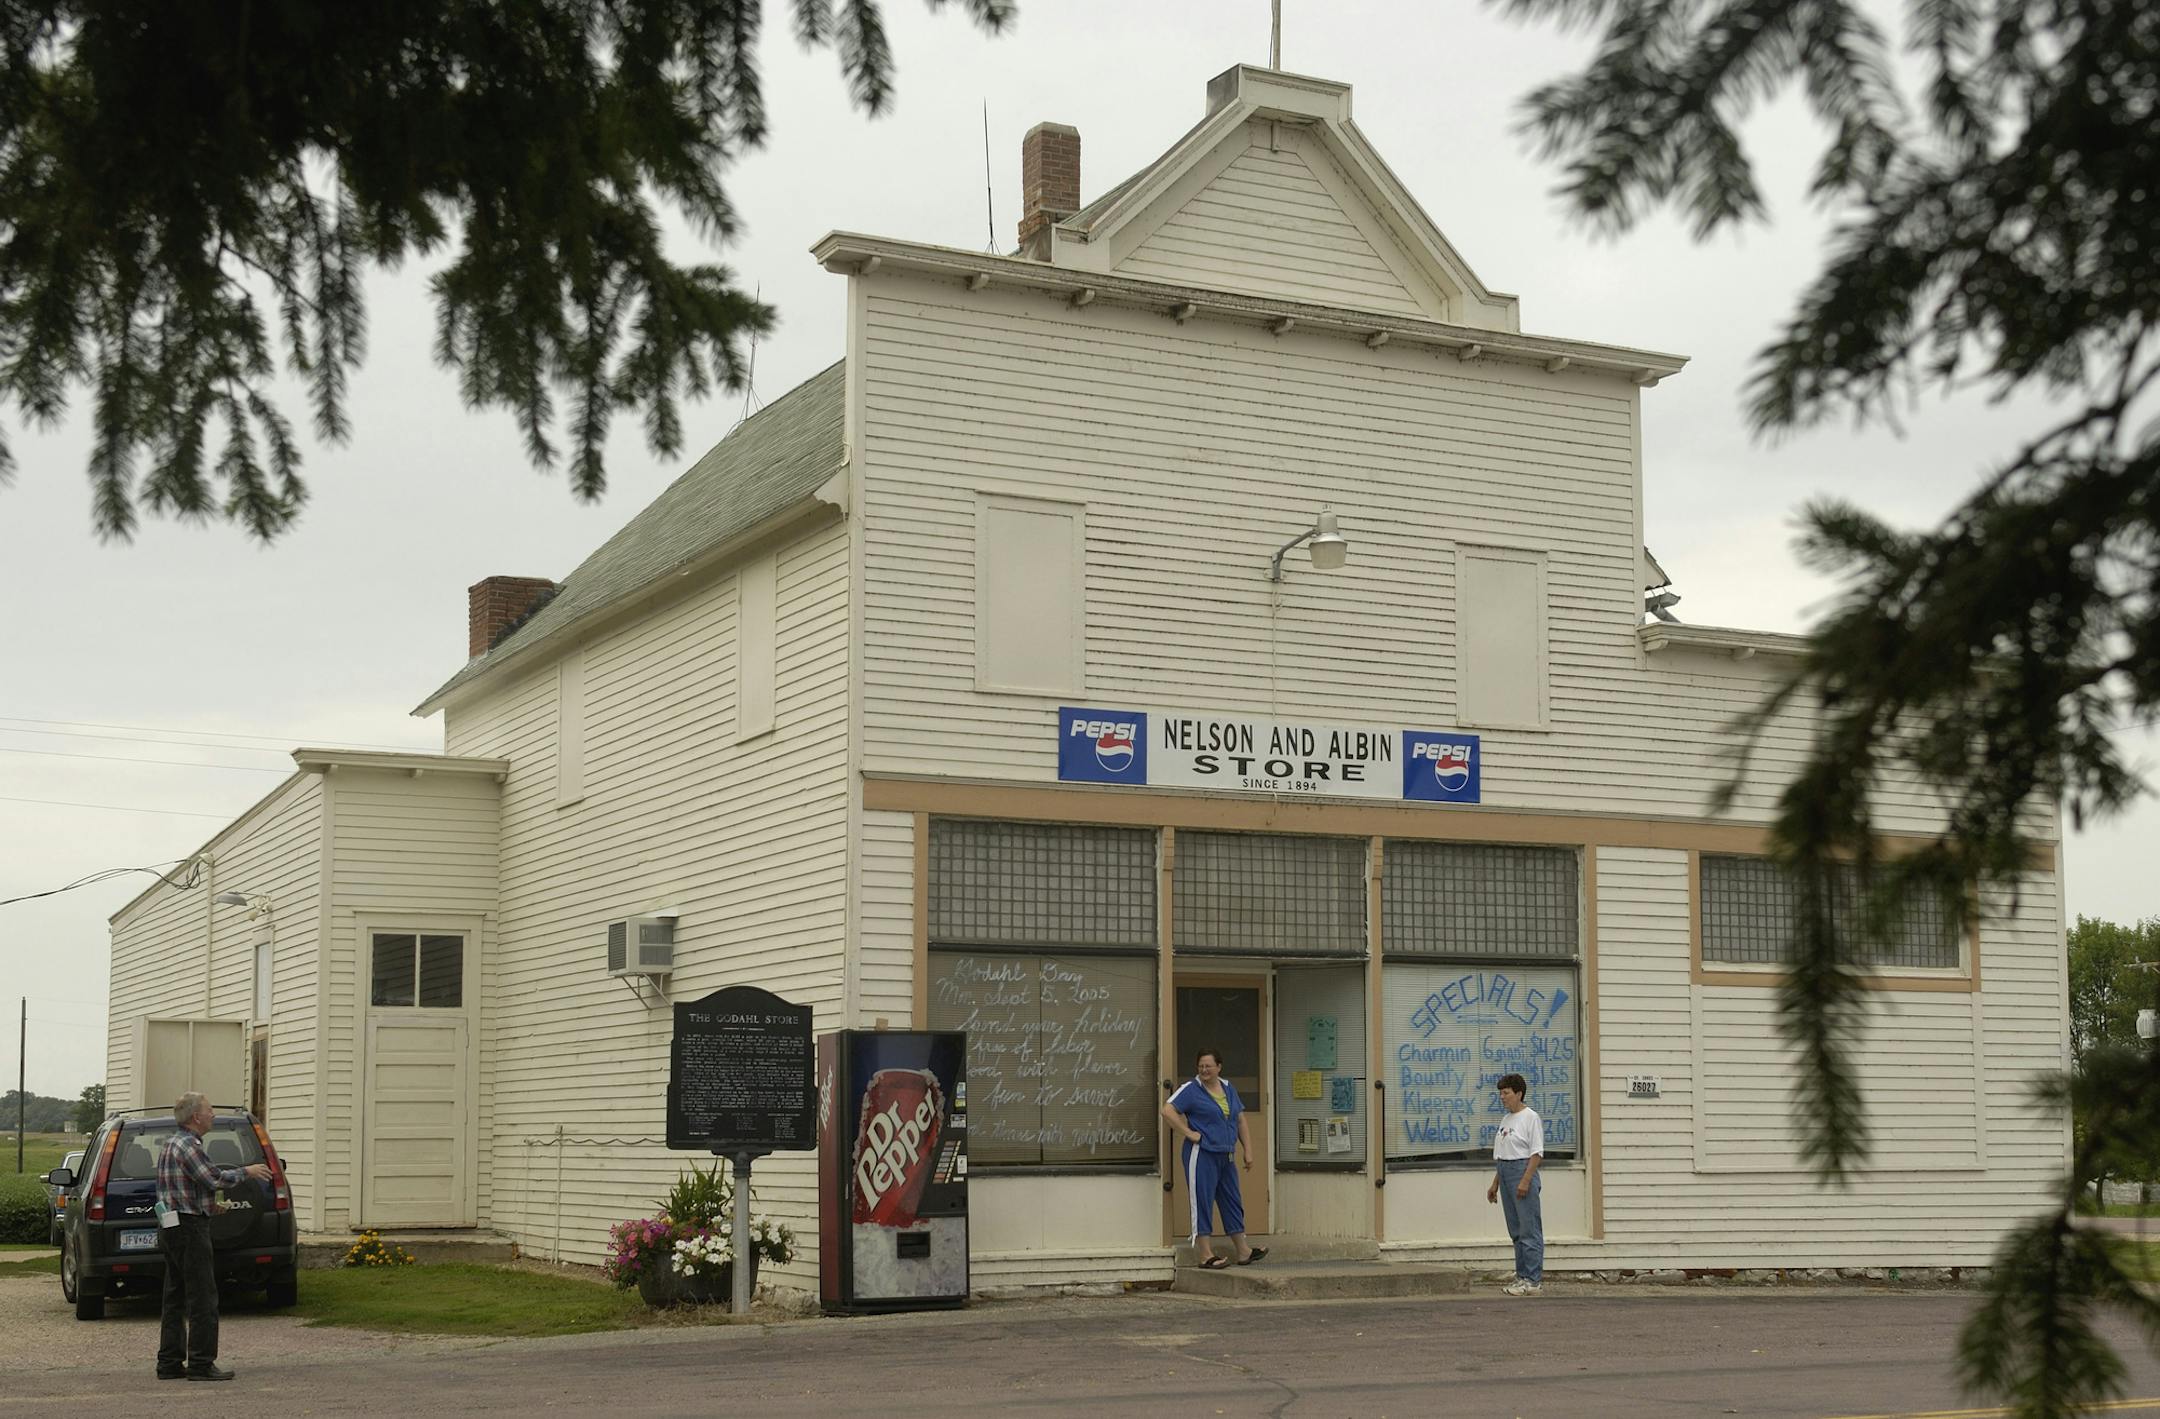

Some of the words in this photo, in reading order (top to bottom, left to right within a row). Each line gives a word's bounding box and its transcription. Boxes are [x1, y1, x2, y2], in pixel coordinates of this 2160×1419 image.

[1070, 719, 1137, 741] PEPSI
[1164, 718, 1254, 754] NELSON
[1269, 726, 1315, 757] AND
[1328, 730, 1392, 762] ALBIN
[1412, 742, 1474, 762] PEPSI
[1192, 754, 1366, 782] STORE
[1242, 778, 1279, 790] SINCE
[1287, 781, 1318, 792] 1894
[688, 1013, 711, 1023] THE
[715, 1013, 760, 1025] GODAHL
[764, 1014, 799, 1025] STORE
[1410, 973, 1569, 1039] SPECIALS!
[1399, 1043, 1472, 1062] Charmin
[1530, 1031, 1574, 1063] $4.25
[1401, 1063, 1466, 1095] Bounty
[1402, 1090, 1476, 1115] Kleenex
[866, 1100, 904, 1160] Dr
[1404, 1113, 1471, 1143] Welch's
[857, 1087, 938, 1213] Pepper
